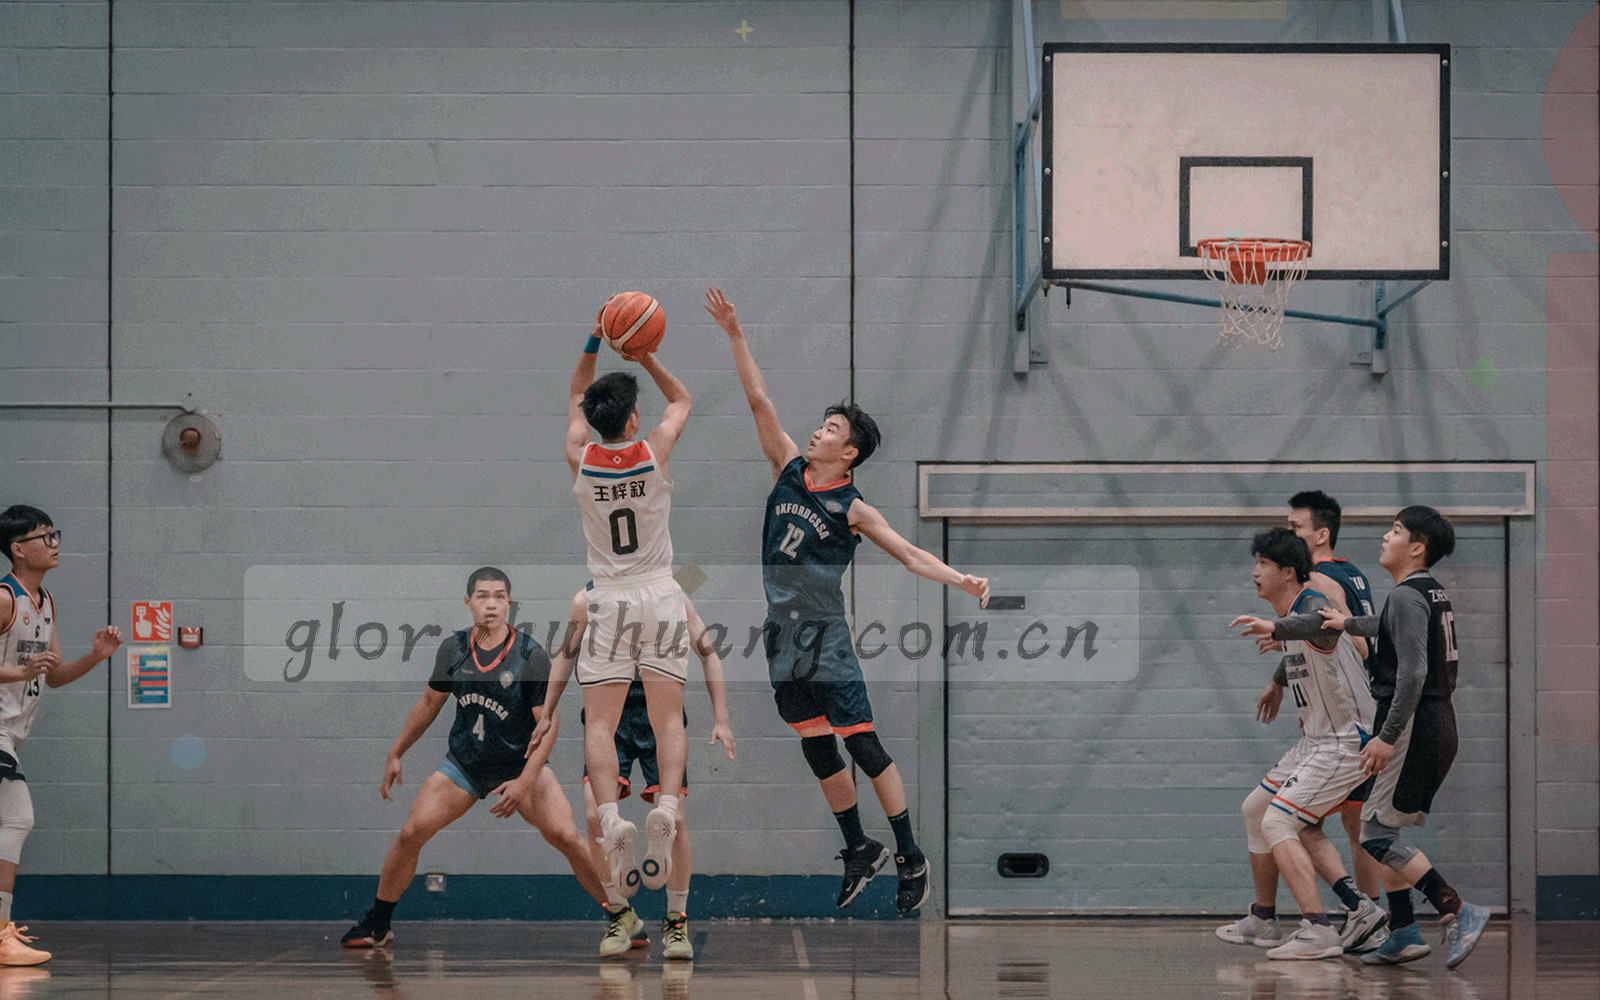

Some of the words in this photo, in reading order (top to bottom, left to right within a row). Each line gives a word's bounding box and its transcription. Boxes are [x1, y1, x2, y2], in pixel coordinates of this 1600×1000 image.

[593, 480, 646, 502] 王梓叙
[609, 508, 638, 555] 0
[779, 522, 805, 559] 12
[1292, 683, 1308, 708] 11
[472, 713, 485, 741] 4
